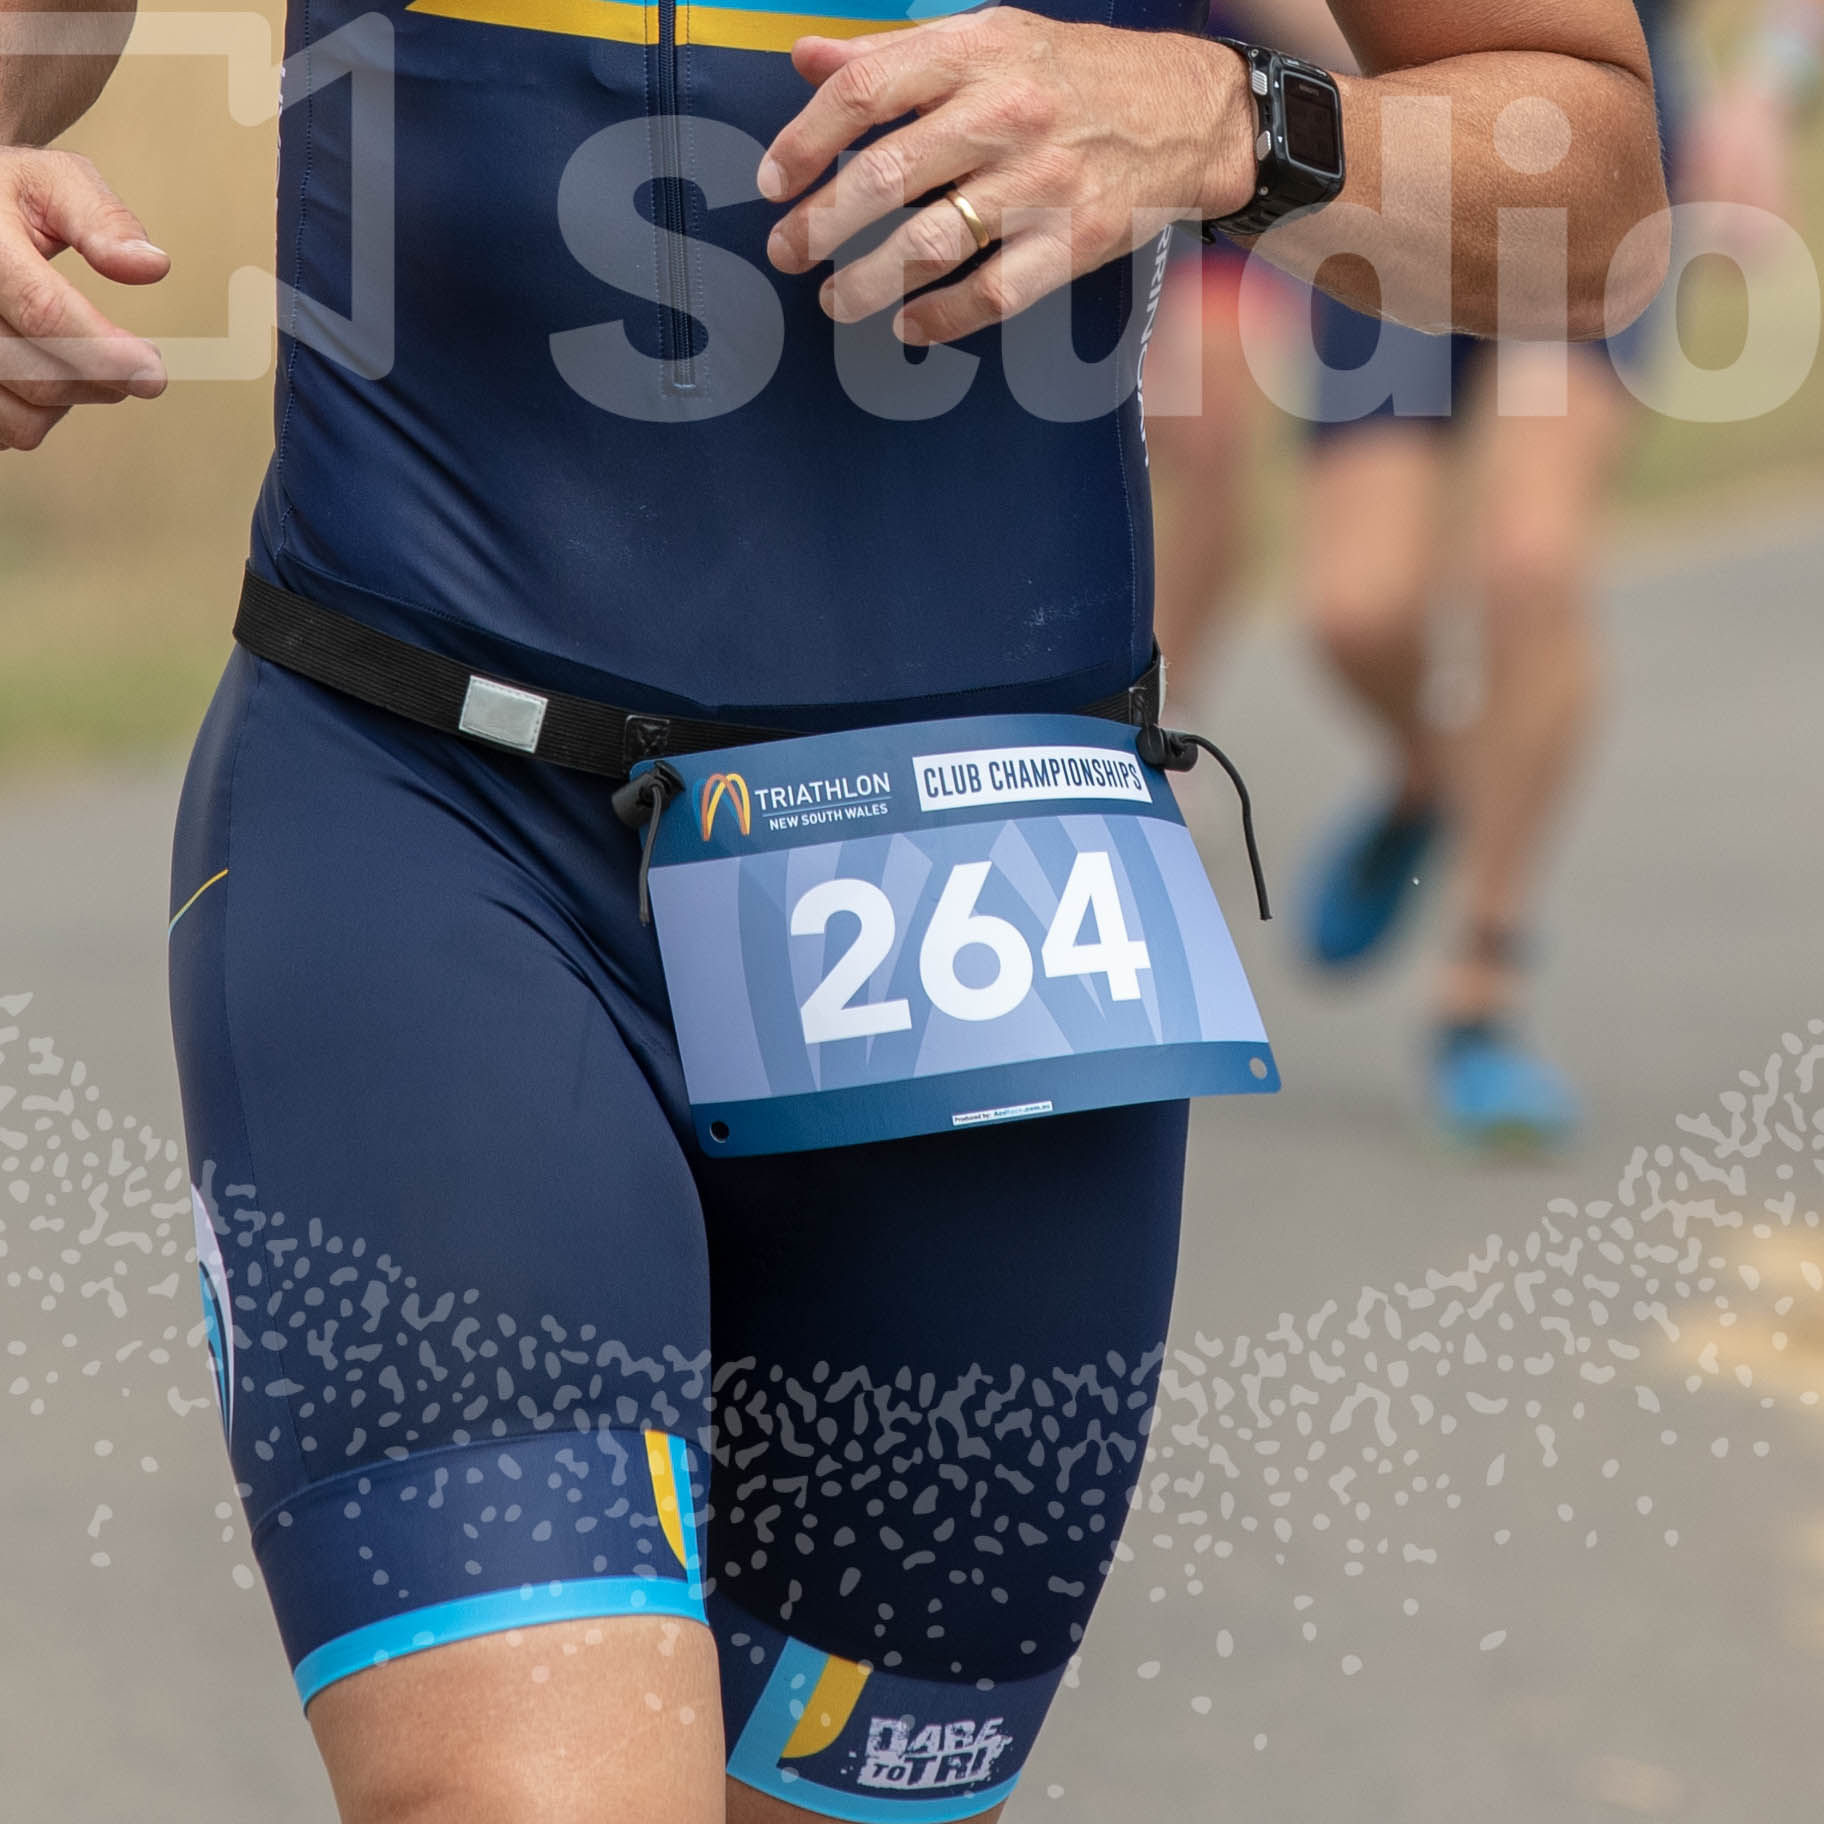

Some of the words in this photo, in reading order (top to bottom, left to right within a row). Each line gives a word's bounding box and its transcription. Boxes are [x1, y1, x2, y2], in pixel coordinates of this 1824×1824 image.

[755, 772, 891, 811] TRIATHLON
[923, 763, 981, 798] CLUB
[989, 758, 1142, 793] CHAMPIONSHIPS
[769, 816, 800, 831] NEW
[801, 810, 844, 827] SOUTH
[845, 803, 889, 820] WALES
[790, 851, 1152, 1044] 264
[872, 1763, 907, 1781] TO
[905, 1747, 988, 1786] TRI
